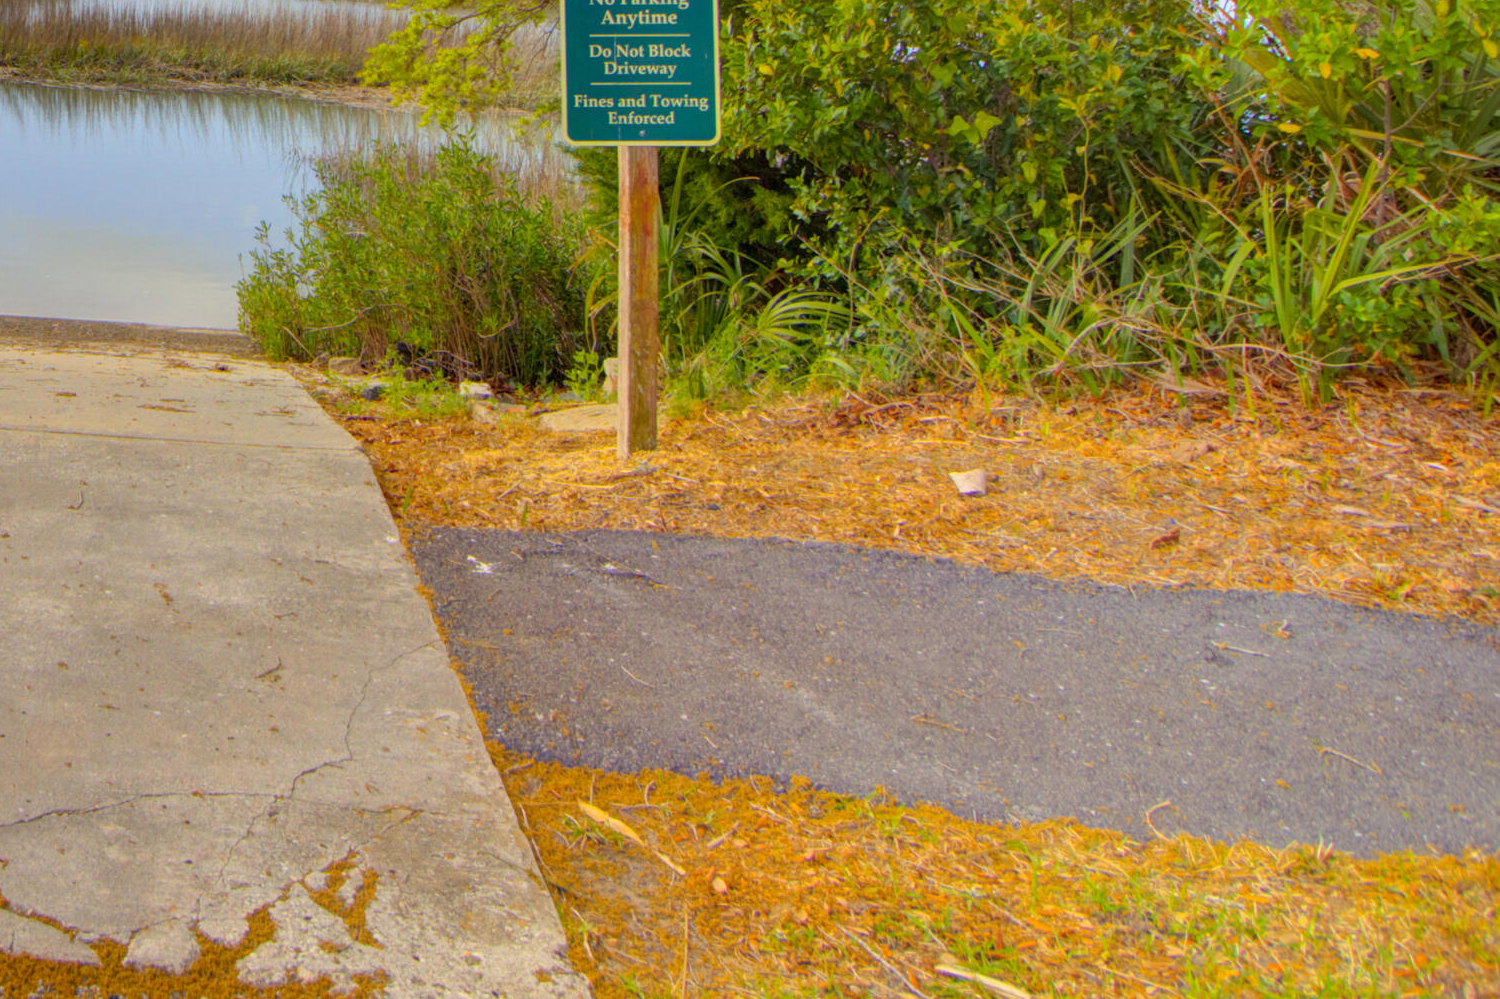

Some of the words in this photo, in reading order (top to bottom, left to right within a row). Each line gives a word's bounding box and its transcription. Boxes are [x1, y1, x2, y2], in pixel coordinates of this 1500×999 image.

[601, 9, 678, 30] Anytime
[589, 44, 612, 58] Do
[616, 44, 644, 58] Not
[648, 44, 691, 58] Block
[604, 61, 677, 79] Driveway
[573, 94, 614, 108] Fines
[618, 94, 646, 108] and
[649, 94, 709, 111] Towing
[607, 111, 675, 125] Enforced
